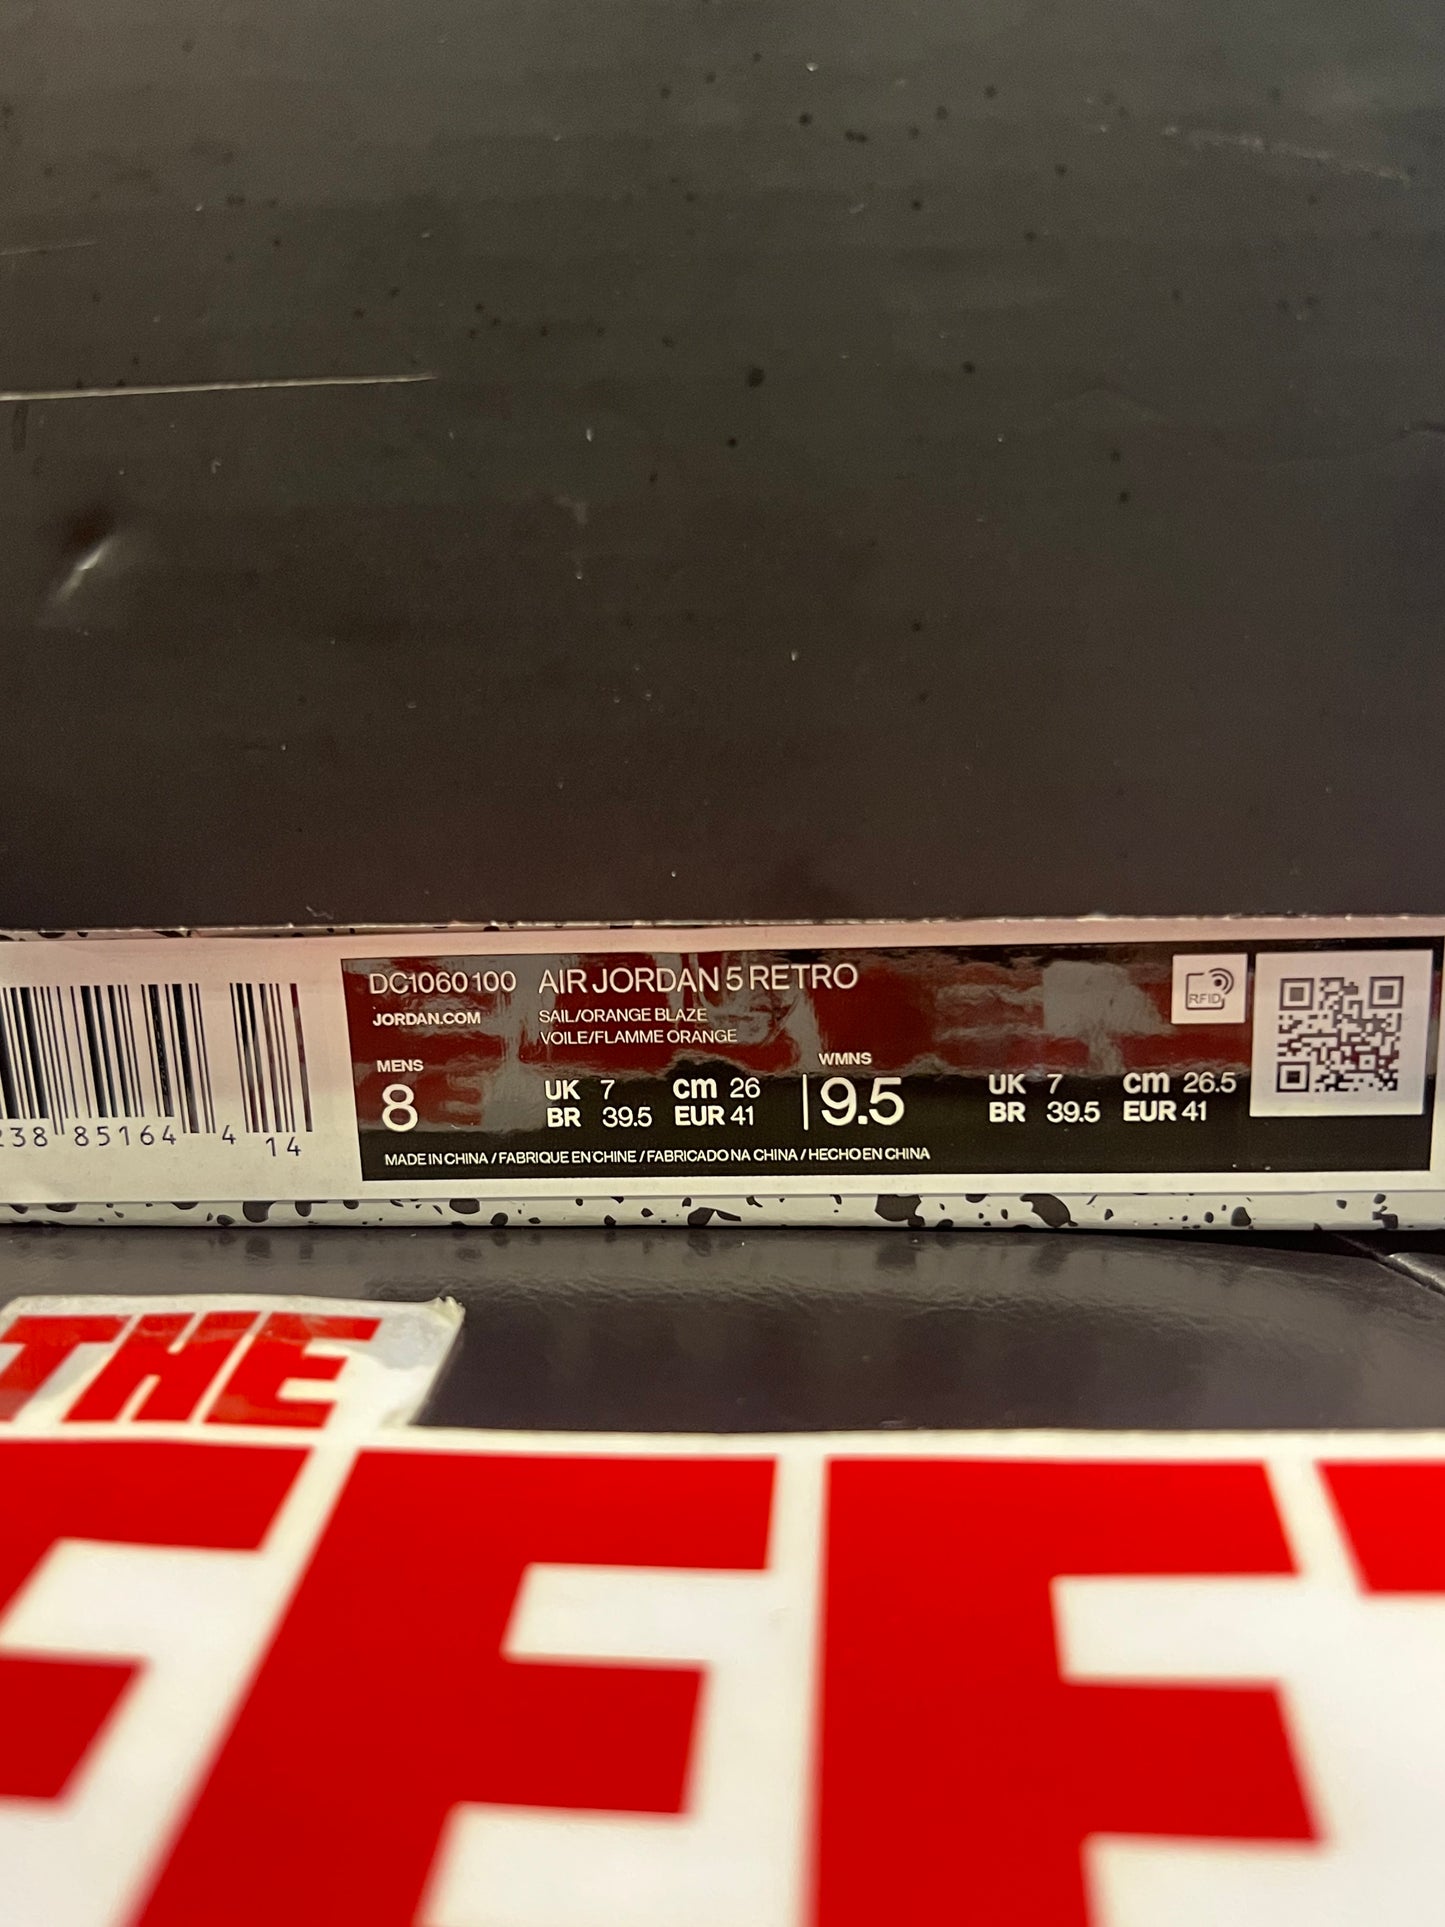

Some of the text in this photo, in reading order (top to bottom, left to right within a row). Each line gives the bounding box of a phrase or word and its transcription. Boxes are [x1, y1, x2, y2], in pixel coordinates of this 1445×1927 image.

[538, 963, 858, 994] AIR JORDAN 5 RETRO
[1188, 992, 1222, 1005] RFID
[372, 1011, 481, 1027] JORDAN.COM
[538, 1007, 708, 1024] SAIL/ORANGE BLAZE
[539, 1028, 738, 1045] VOILE/FLAMME ORANGE
[376, 1059, 424, 1073] MENS
[818, 1052, 872, 1066] WMNS
[544, 1079, 615, 1100] UK 7
[672, 1077, 761, 1099] cm 26
[988, 1073, 1063, 1095] UK 7
[1122, 1072, 1237, 1094] cm 26.5
[381, 1083, 418, 1132] 8
[820, 1077, 905, 1126] 9.5
[988, 1101, 1101, 1123] BR 39.5
[1122, 1100, 1208, 1122] EUR 41
[547, 1106, 652, 1128] BR 39.5
[674, 1105, 755, 1127] EUR 41
[221, 1124, 237, 1145] 4
[385, 1152, 427, 1166] MADE
[428, 1152, 443, 1165] IN
[443, 1152, 489, 1165] CHINA
[498, 1150, 569, 1165] FABRIQUE
[571, 1151, 591, 1164] EN
[591, 1150, 637, 1164] CHINE
[647, 1150, 729, 1163] FABRICADO
[730, 1149, 751, 1162] NA
[753, 1148, 799, 1162] CHINA
[808, 1148, 861, 1161] HECHO
[862, 1147, 883, 1160] EN
[884, 1147, 931, 1160] CHINA
[0, 1311, 382, 1429] THE
